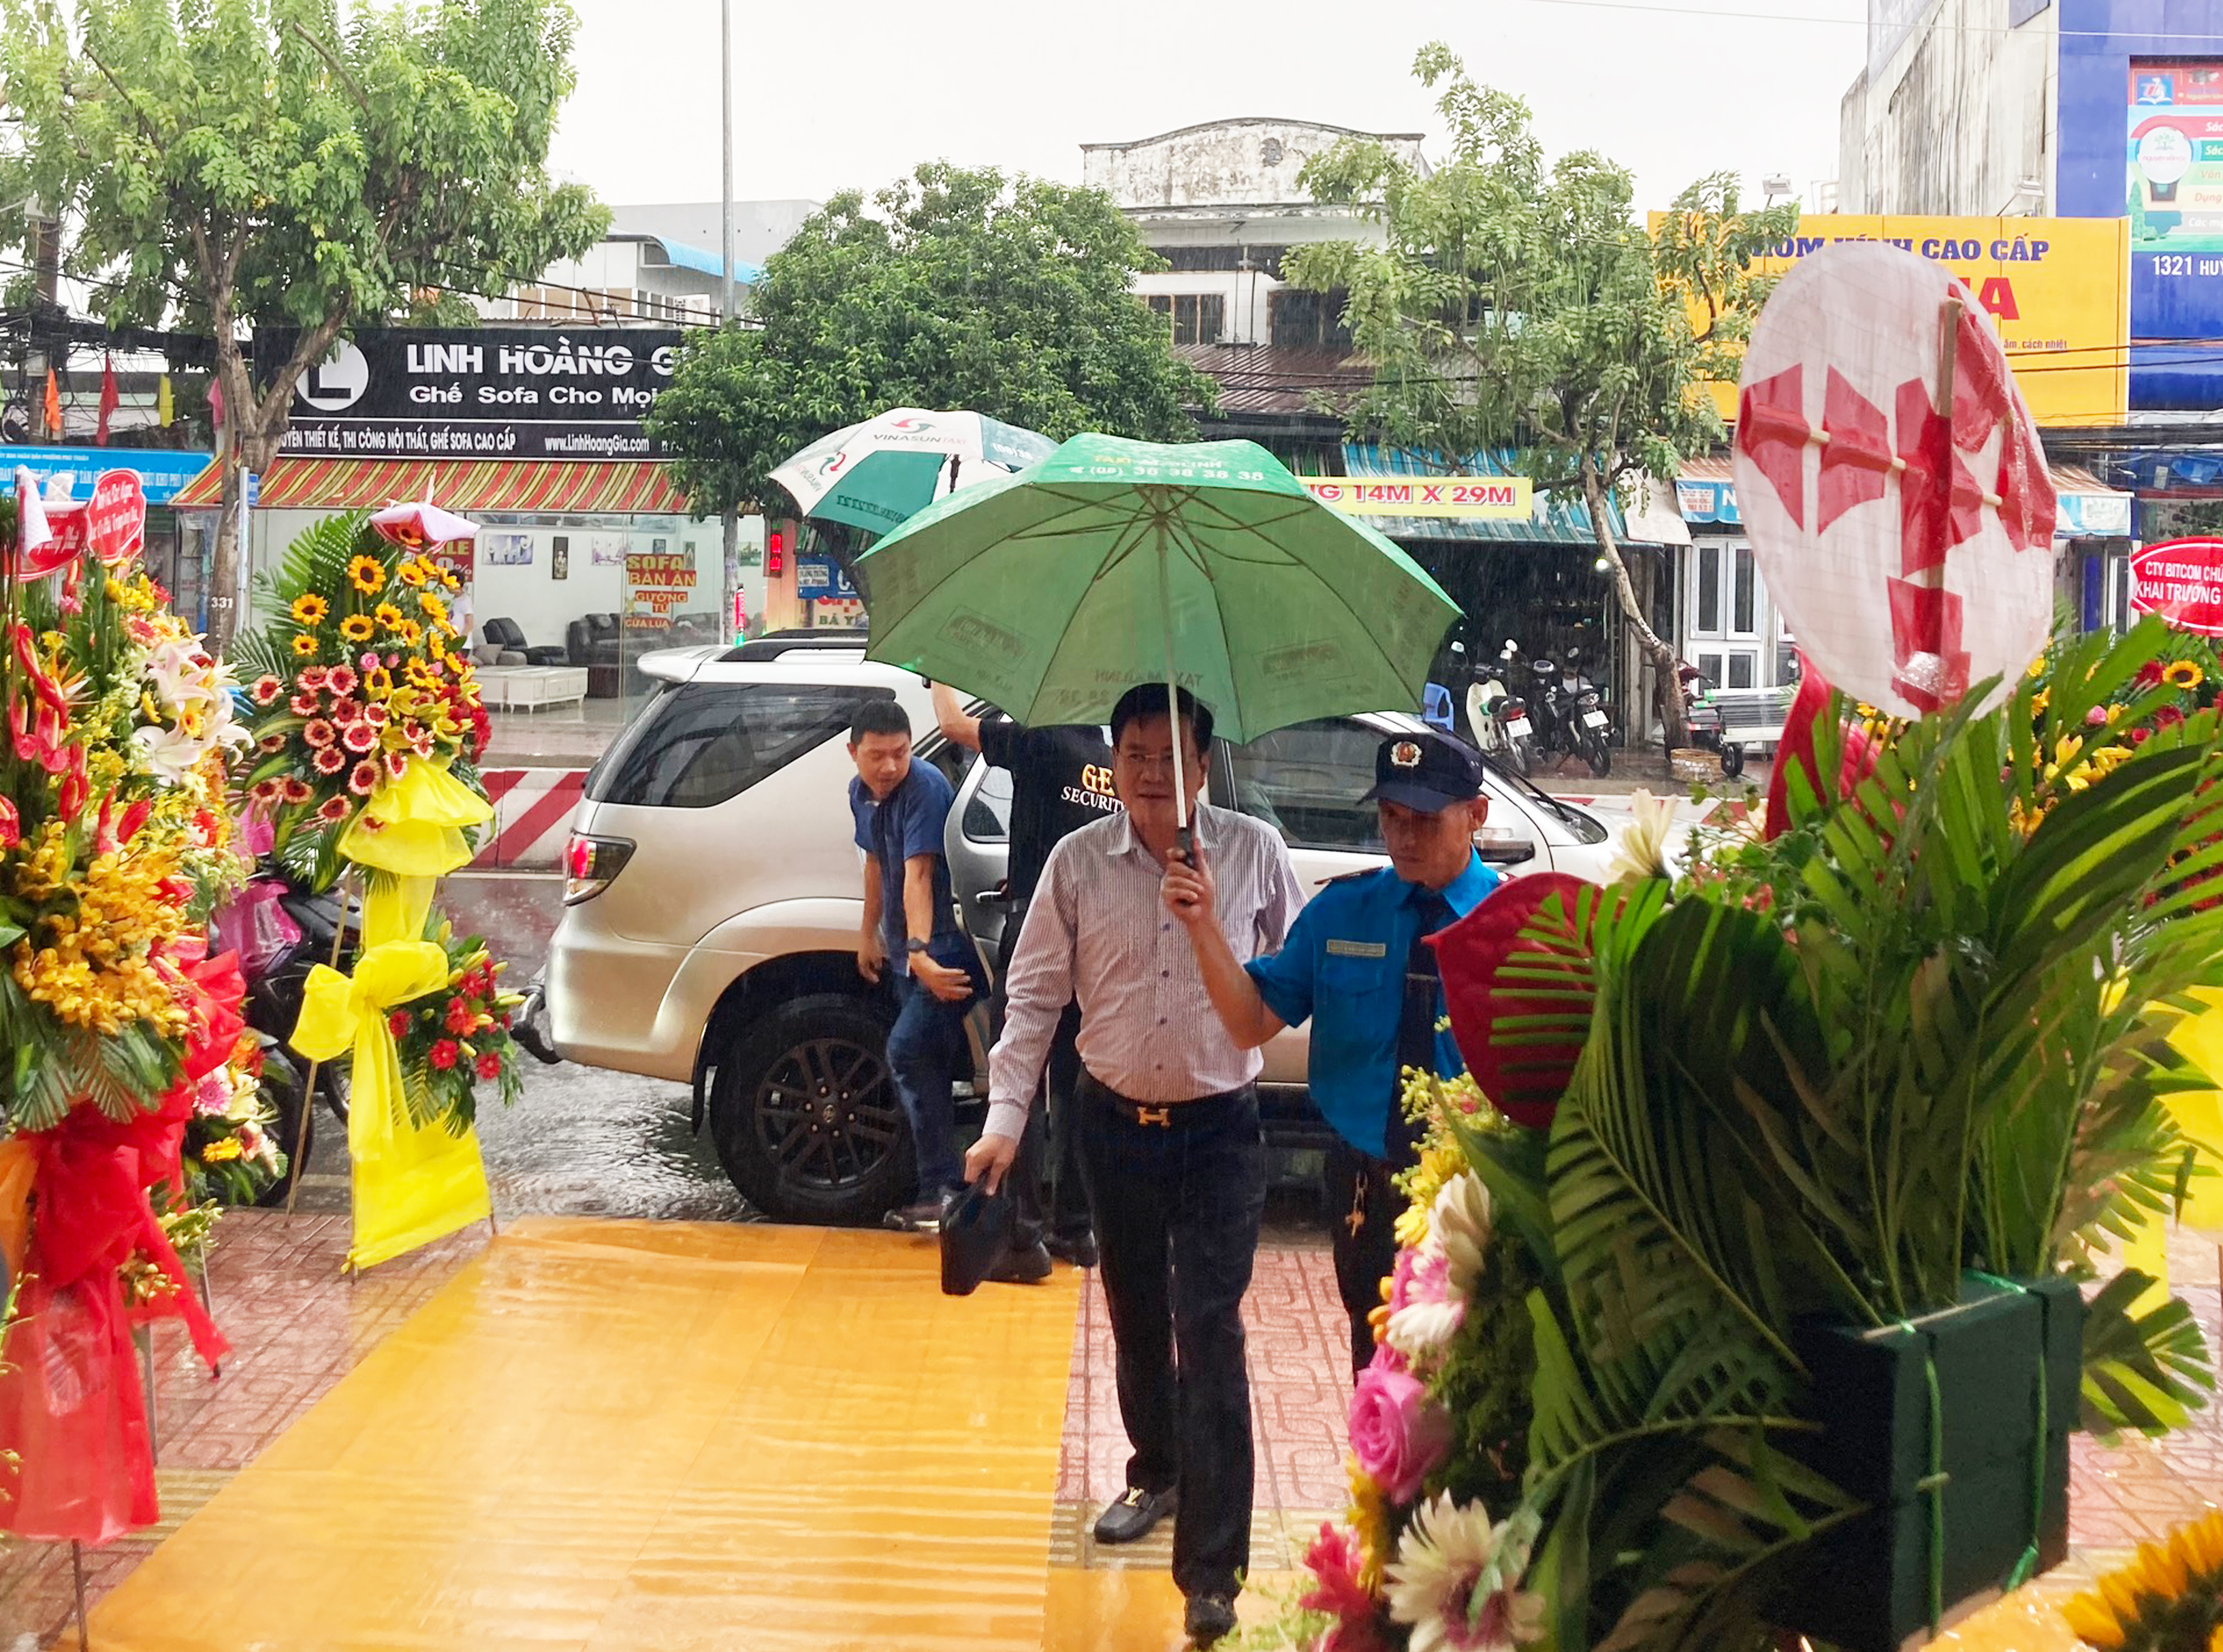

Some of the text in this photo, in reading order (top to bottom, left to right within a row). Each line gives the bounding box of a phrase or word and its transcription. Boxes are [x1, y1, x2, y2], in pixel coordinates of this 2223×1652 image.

[1921, 238, 1981, 261] CAO
[1990, 232, 2049, 261] CẤP
[2153, 255, 2192, 275] 1321
[407, 344, 483, 374] LINH
[499, 335, 633, 375] HOÀNG
[409, 383, 463, 403] Ghế
[478, 386, 539, 404] Sofa
[549, 386, 602, 404] Cho
[304, 424, 326, 449] THIẾT
[342, 430, 357, 449] THI
[358, 426, 386, 449] CÔNG
[387, 427, 404, 454] NỘI
[430, 426, 449, 449] GHẾ
[450, 432, 473, 450] SOFA
[475, 432, 496, 451] CAO
[496, 426, 516, 451] CẤP
[545, 433, 650, 456] www.LinhHoangGia.com
[1203, 469, 1229, 479] 38
[1238, 471, 1264, 481] 38
[1352, 484, 1413, 504] 14M
[1420, 484, 1444, 504] X
[1452, 485, 1516, 506] 29M
[626, 556, 684, 571] SOFA
[2145, 561, 2164, 577] CTY
[2165, 564, 2202, 580] BITCOM
[211, 597, 234, 609] 331
